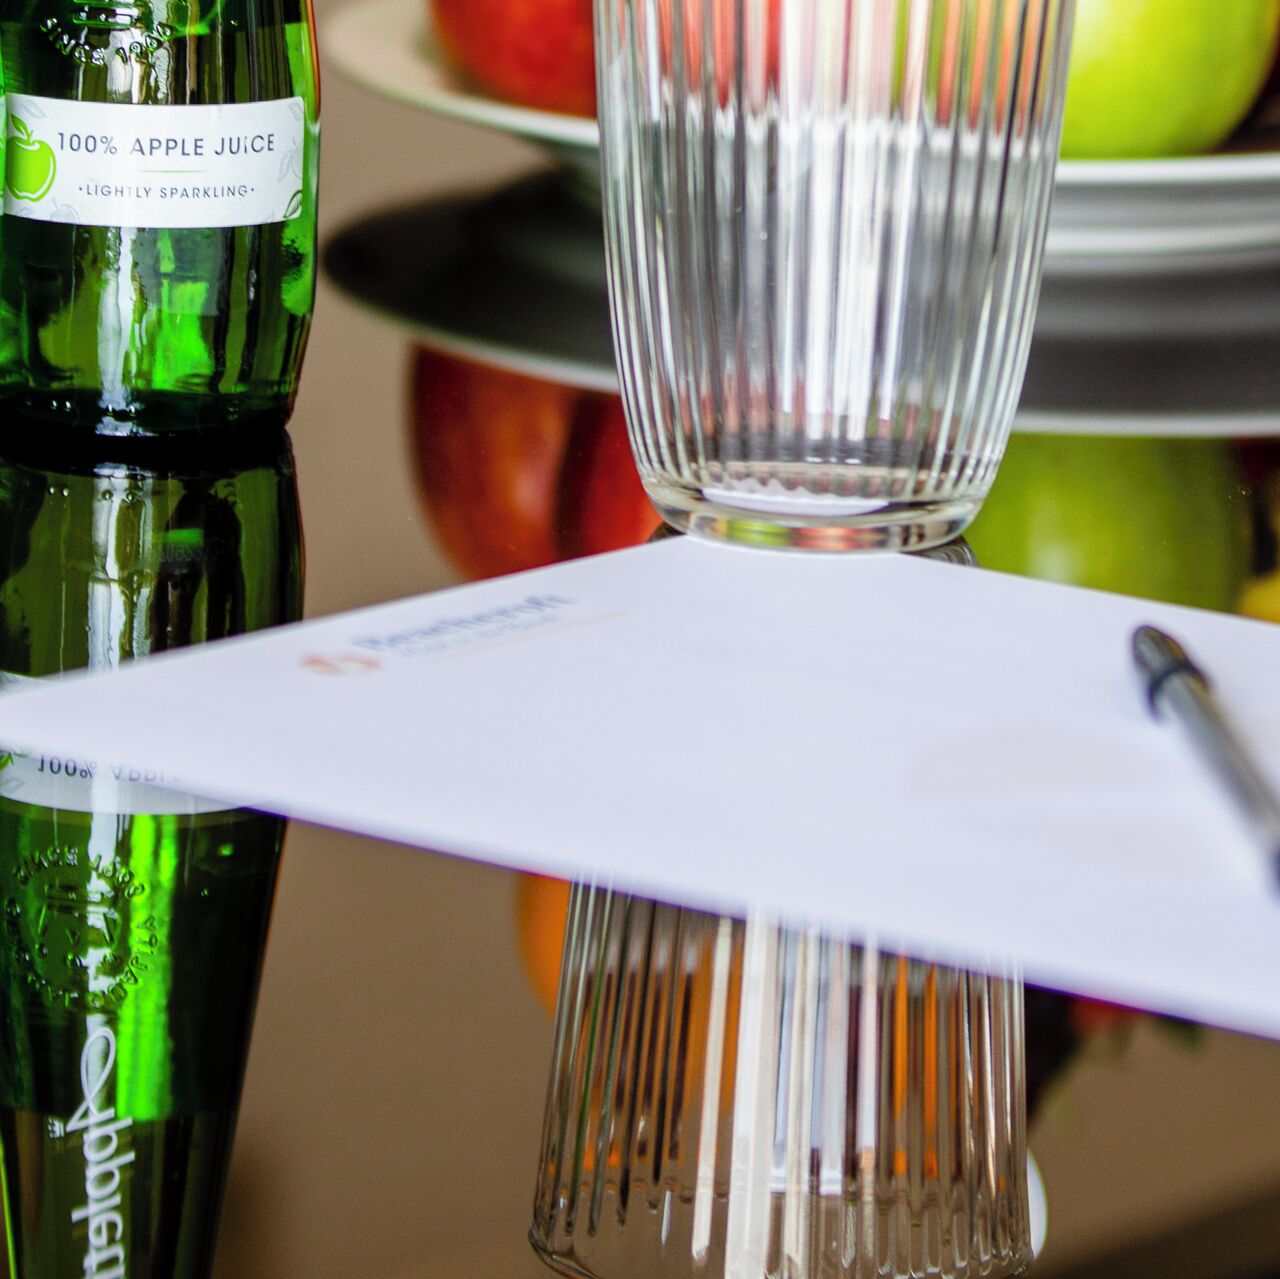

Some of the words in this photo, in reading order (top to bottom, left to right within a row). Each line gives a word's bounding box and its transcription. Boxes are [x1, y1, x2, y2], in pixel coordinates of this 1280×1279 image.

[57, 132, 118, 155] 100%
[130, 137, 204, 156] APPLE
[214, 133, 275, 156] JUICE
[85, 183, 151, 198] LIGHTLY
[159, 185, 248, 199] SPARKLING
